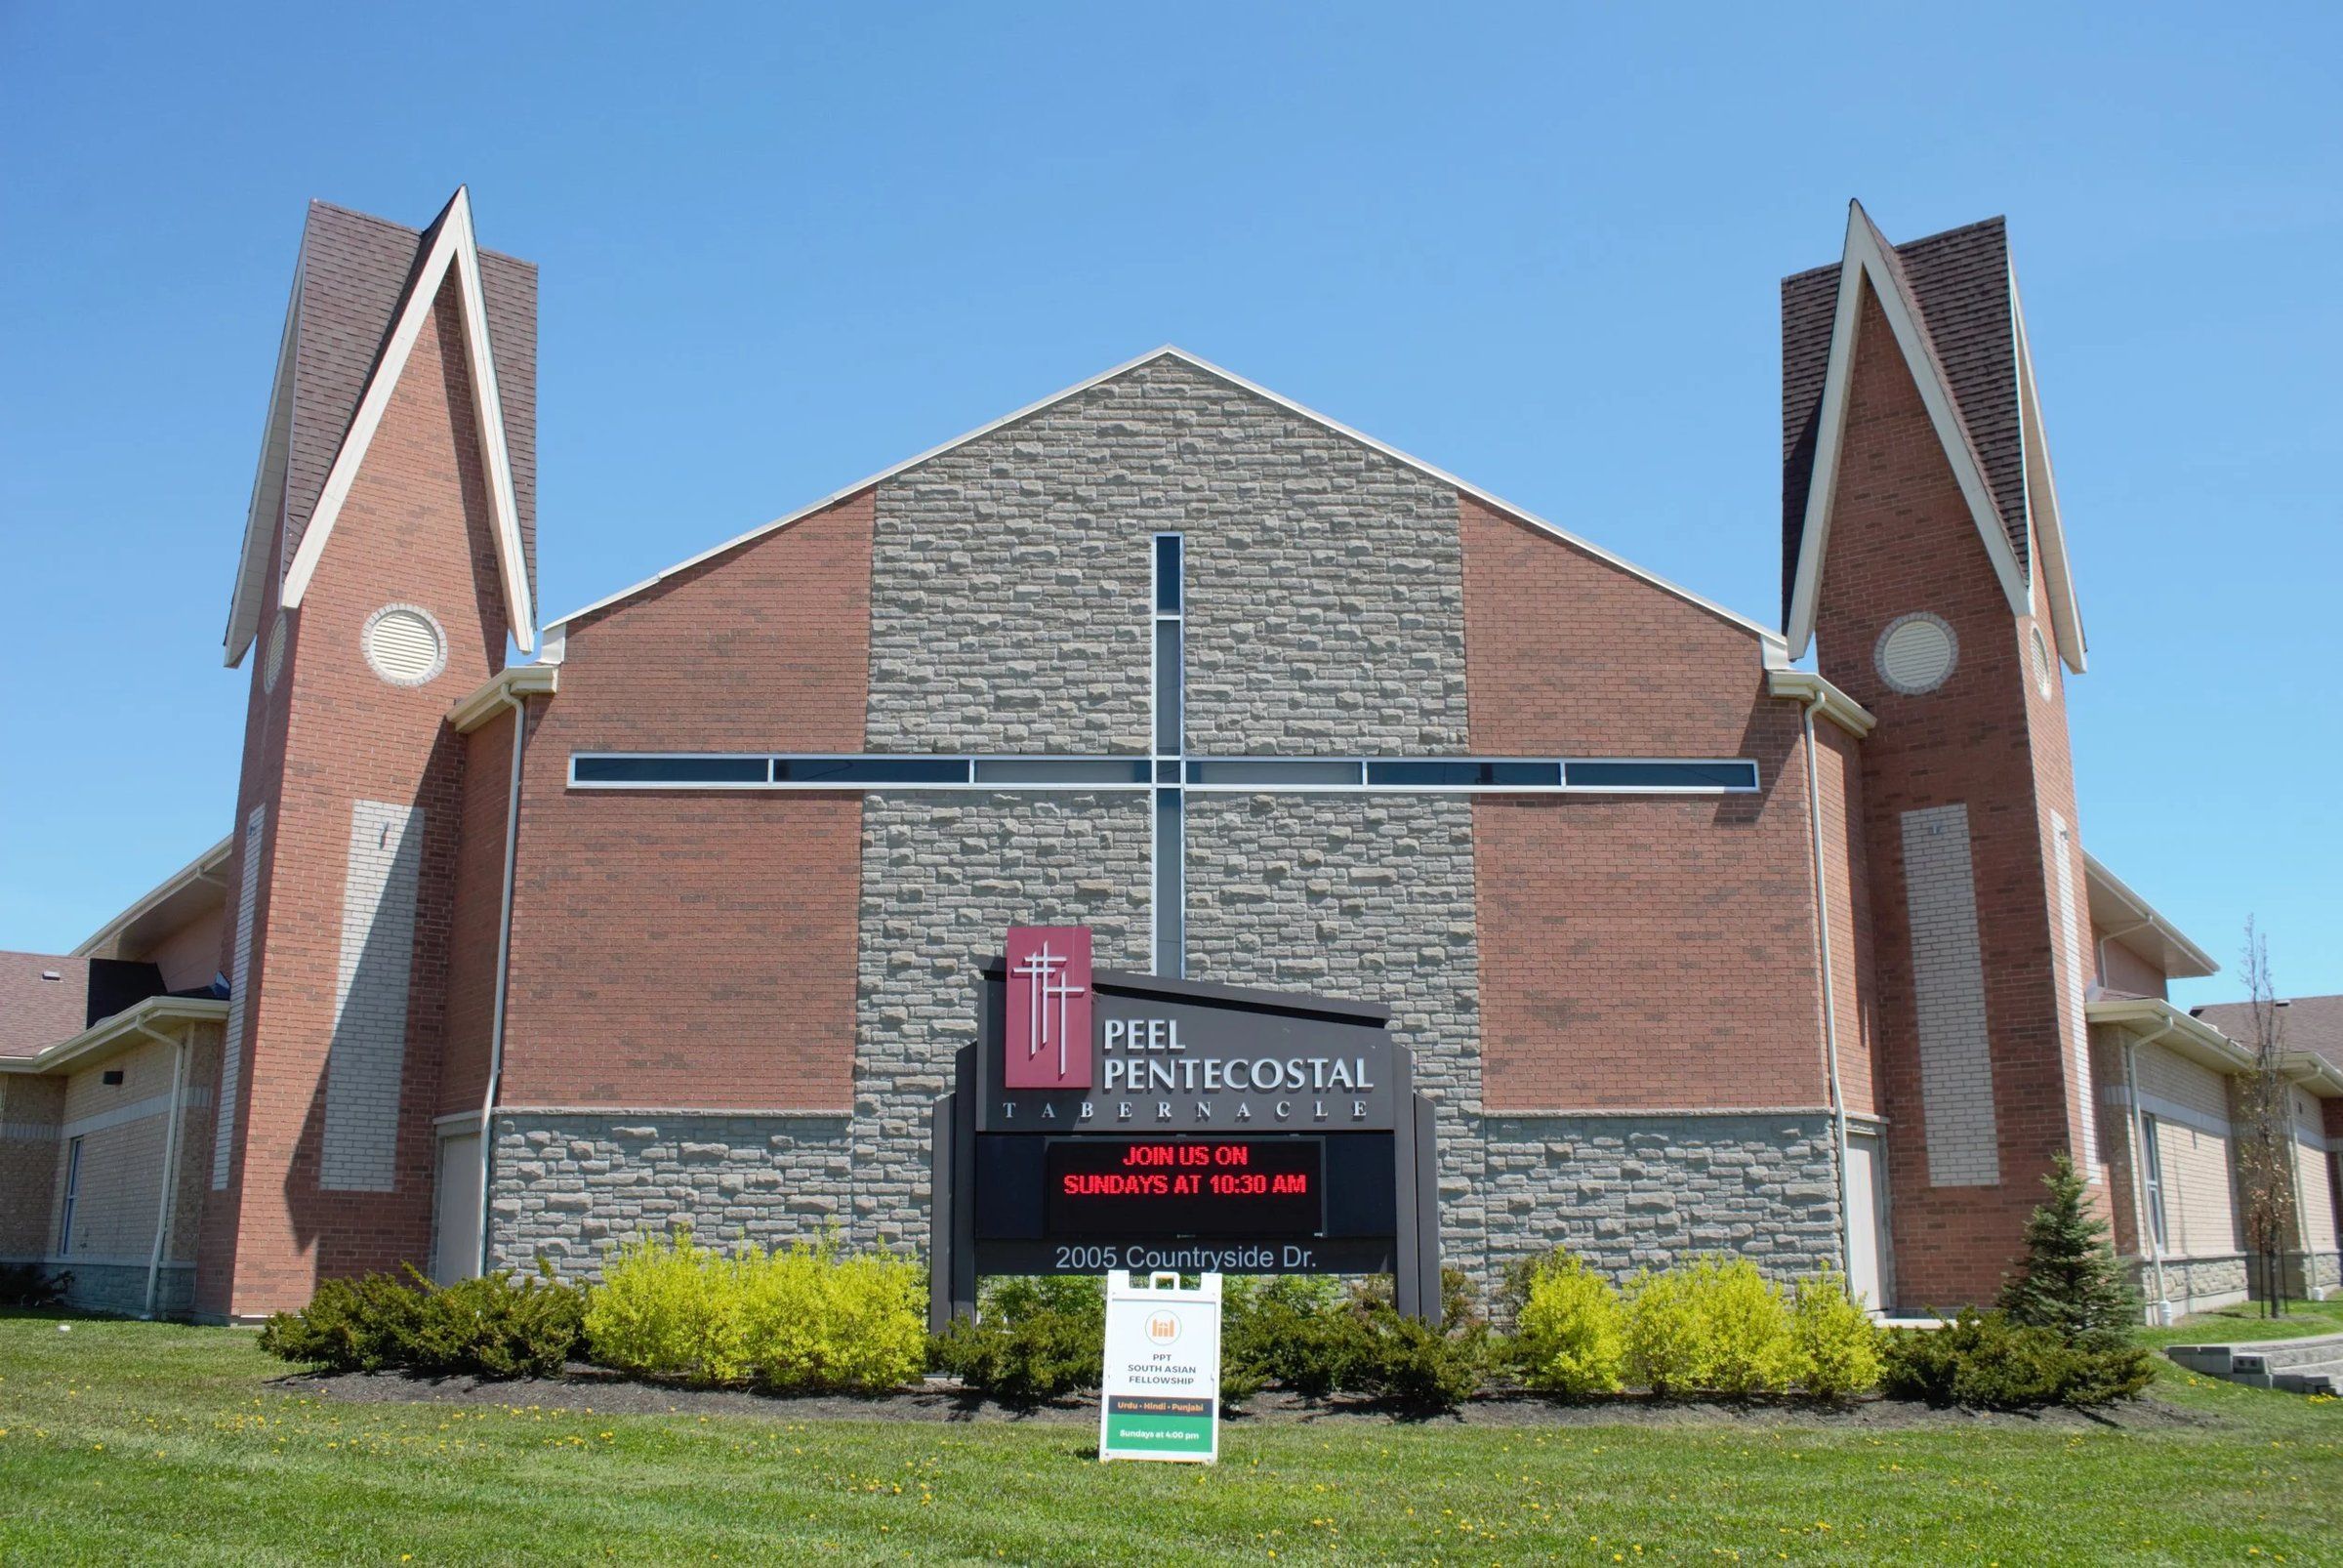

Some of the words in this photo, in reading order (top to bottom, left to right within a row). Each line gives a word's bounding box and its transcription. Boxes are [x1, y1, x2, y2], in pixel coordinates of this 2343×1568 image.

[1103, 1018, 1186, 1051] PEEL
[1103, 1057, 1374, 1091] PENTECOSTAL
[1003, 1101, 1368, 1119] TABERNACLE
[1123, 1146, 1173, 1166] JOIN
[1179, 1146, 1210, 1166] US
[1215, 1146, 1248, 1166] ON
[1064, 1175, 1168, 1194] SUNDAYS
[1173, 1175, 1202, 1194] AT
[1210, 1175, 1266, 1194] 10:30
[1272, 1175, 1306, 1193] AM
[1055, 1246, 1117, 1268] 2005
[1126, 1245, 1274, 1273] Countryside
[1283, 1245, 1316, 1268] Dr.
[1165, 1365, 1196, 1374] ASIAN
[1129, 1376, 1194, 1384] FELLOWSHIP
[1118, 1401, 1138, 1410] Urdu
[1143, 1402, 1167, 1411] Hindi
[1172, 1403, 1204, 1413] Punjabi
[1120, 1429, 1154, 1439] Sundays
[1166, 1430, 1184, 1439] 4:00
